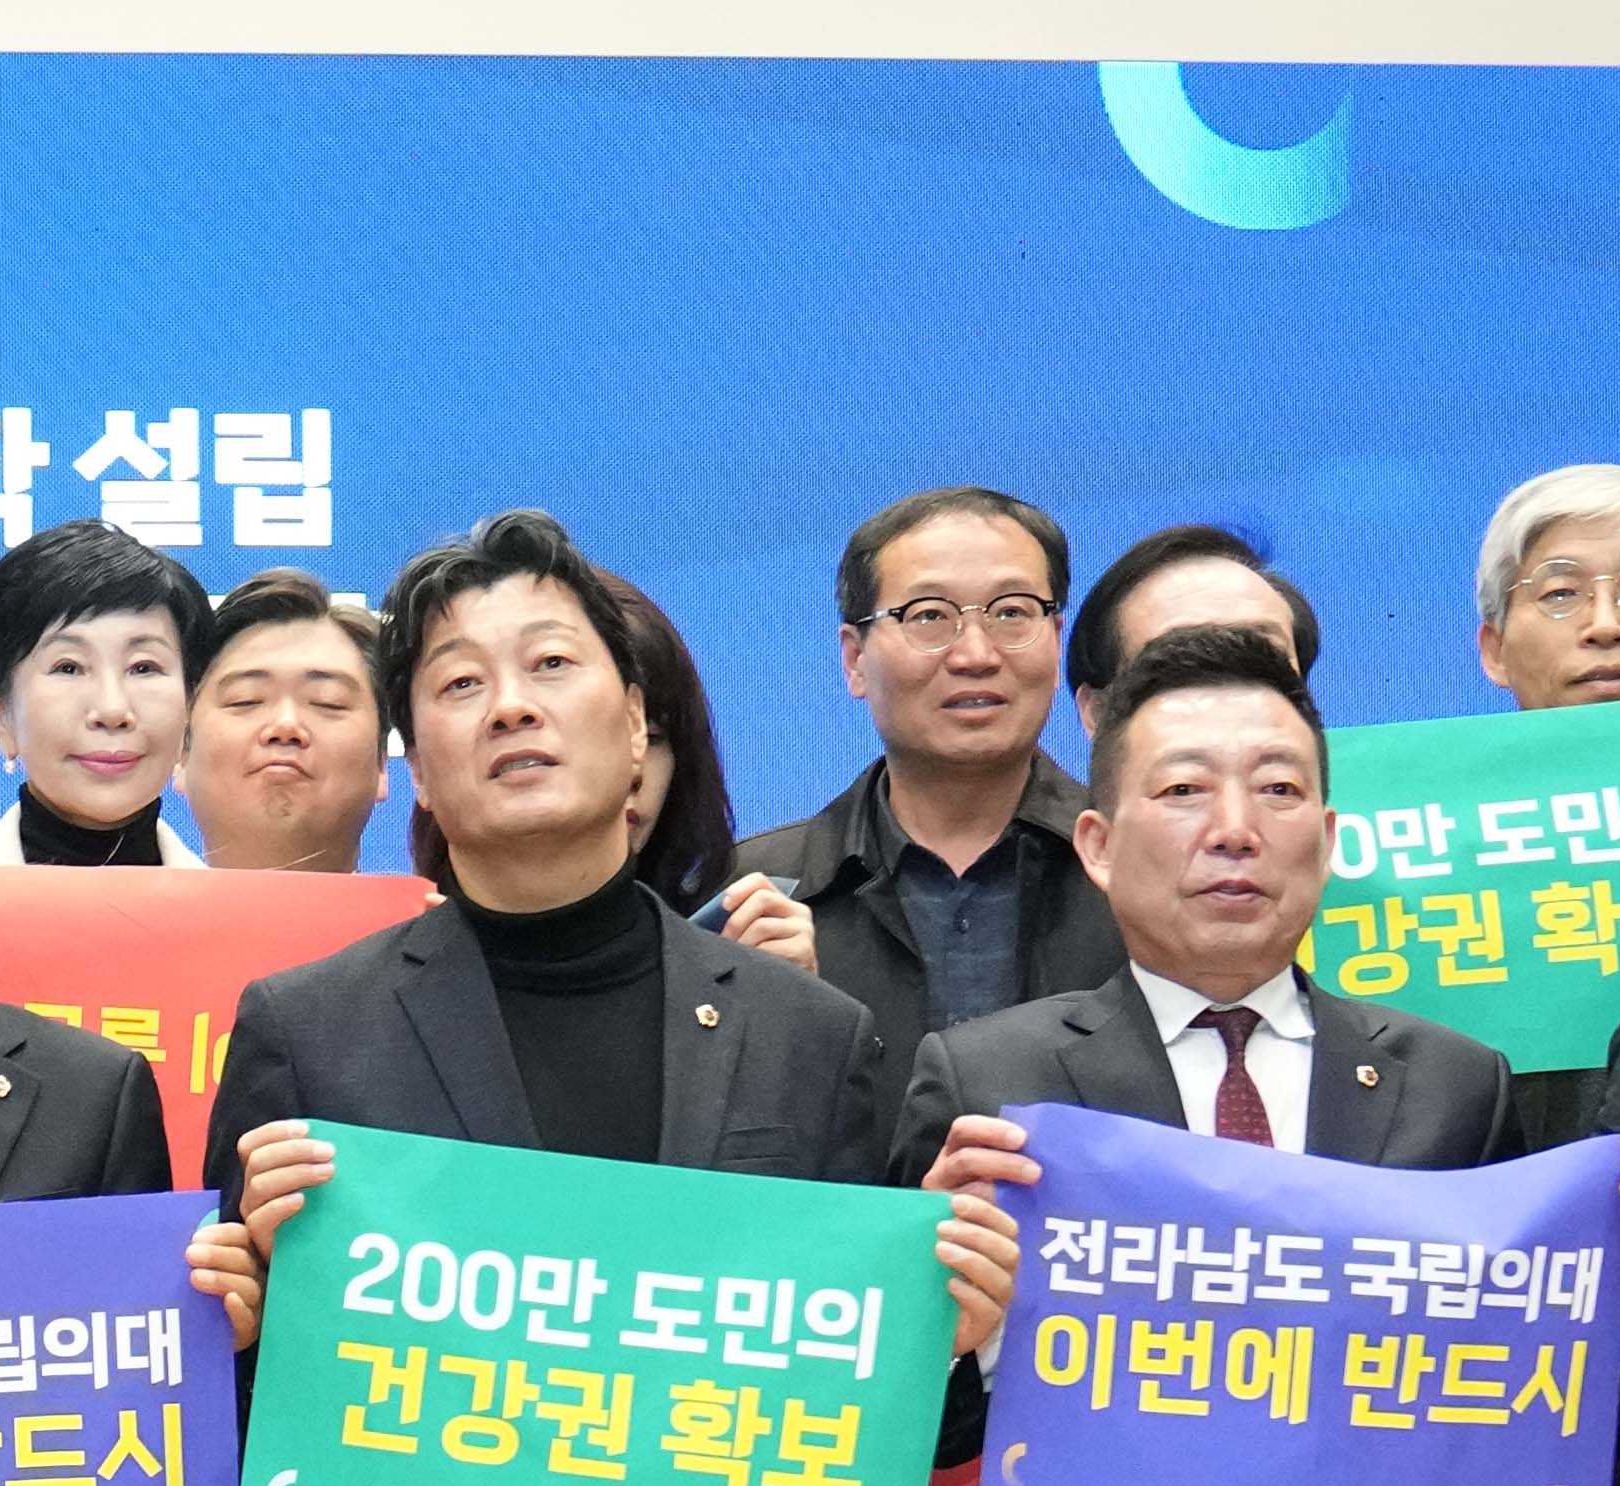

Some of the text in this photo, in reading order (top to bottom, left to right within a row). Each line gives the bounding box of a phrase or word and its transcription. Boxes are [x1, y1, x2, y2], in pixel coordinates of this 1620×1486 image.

[72, 407, 334, 547] 설립
[1328, 802, 1457, 880] 0만
[1297, 888, 1510, 997] 강권
[341, 1232, 884, 1380] 200만 도민의
[1038, 1216, 1605, 1325] 전라남도 국립의대
[337, 1341, 633, 1479] 건강권
[1036, 1315, 1587, 1435] 이번에 반드시
